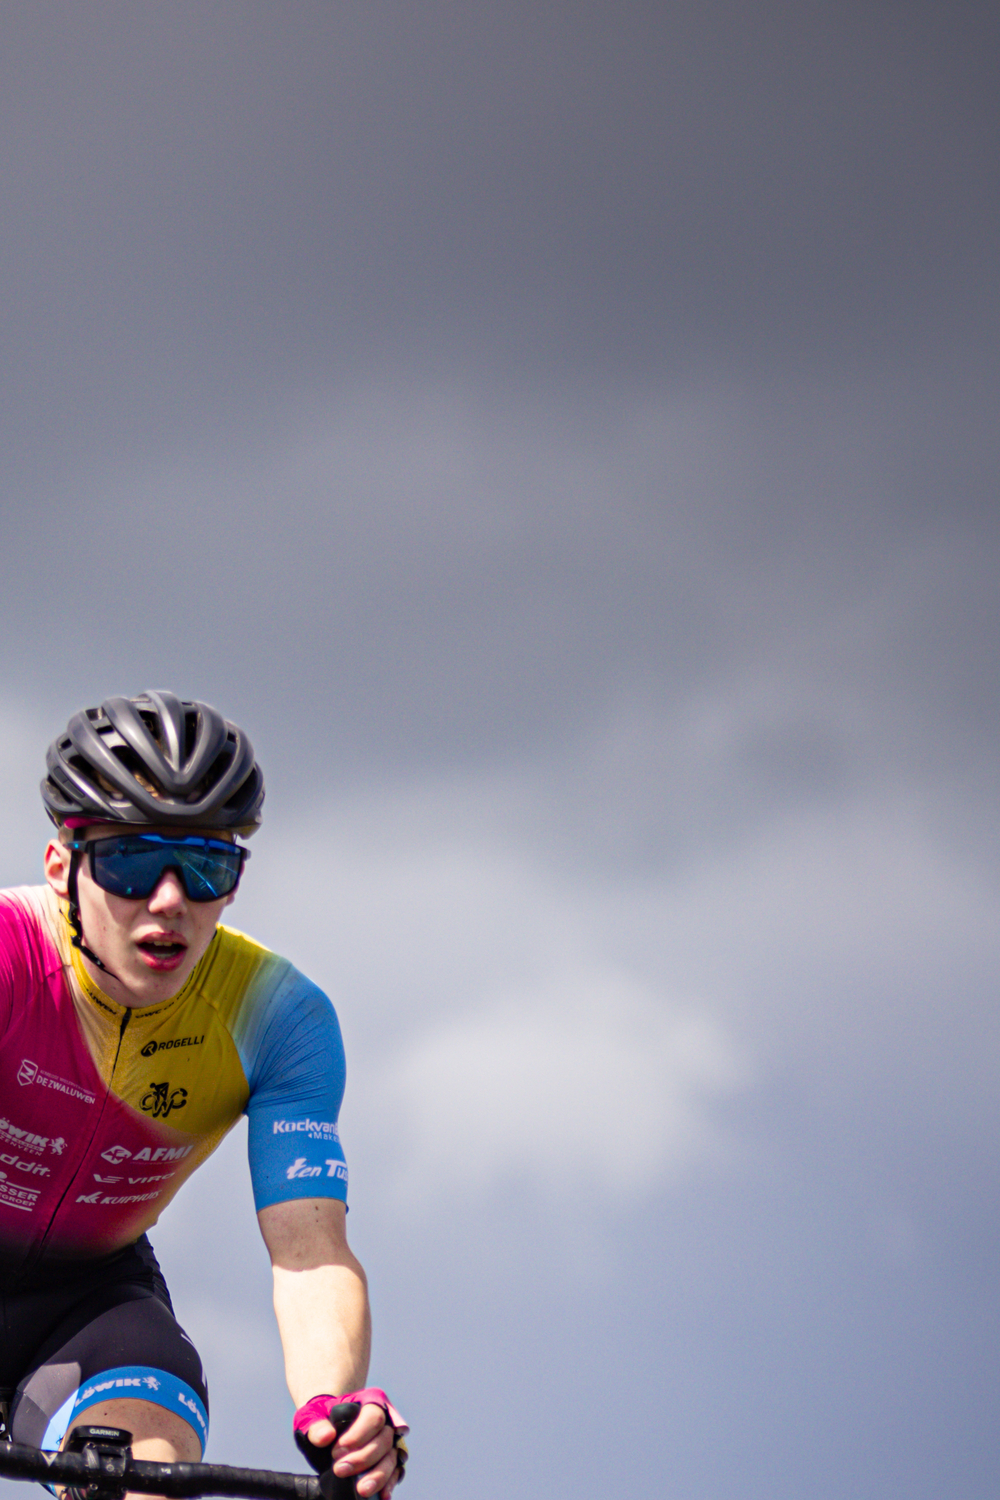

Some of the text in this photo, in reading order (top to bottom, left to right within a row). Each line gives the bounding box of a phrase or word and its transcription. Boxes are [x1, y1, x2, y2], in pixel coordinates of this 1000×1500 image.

[158, 1035, 204, 1051] ROGELLI
[36, 1075, 48, 1087] DE
[48, 1079, 96, 1105] ZWALUWEN
[132, 1145, 194, 1162] AFMI
[286, 1158, 322, 1180] ten
[128, 1172, 175, 1184] VIRO
[100, 1190, 162, 1204] KUIPHUIS
[75, 1378, 141, 1408] LÖWIK
[89, 1428, 120, 1437] GARMIN
